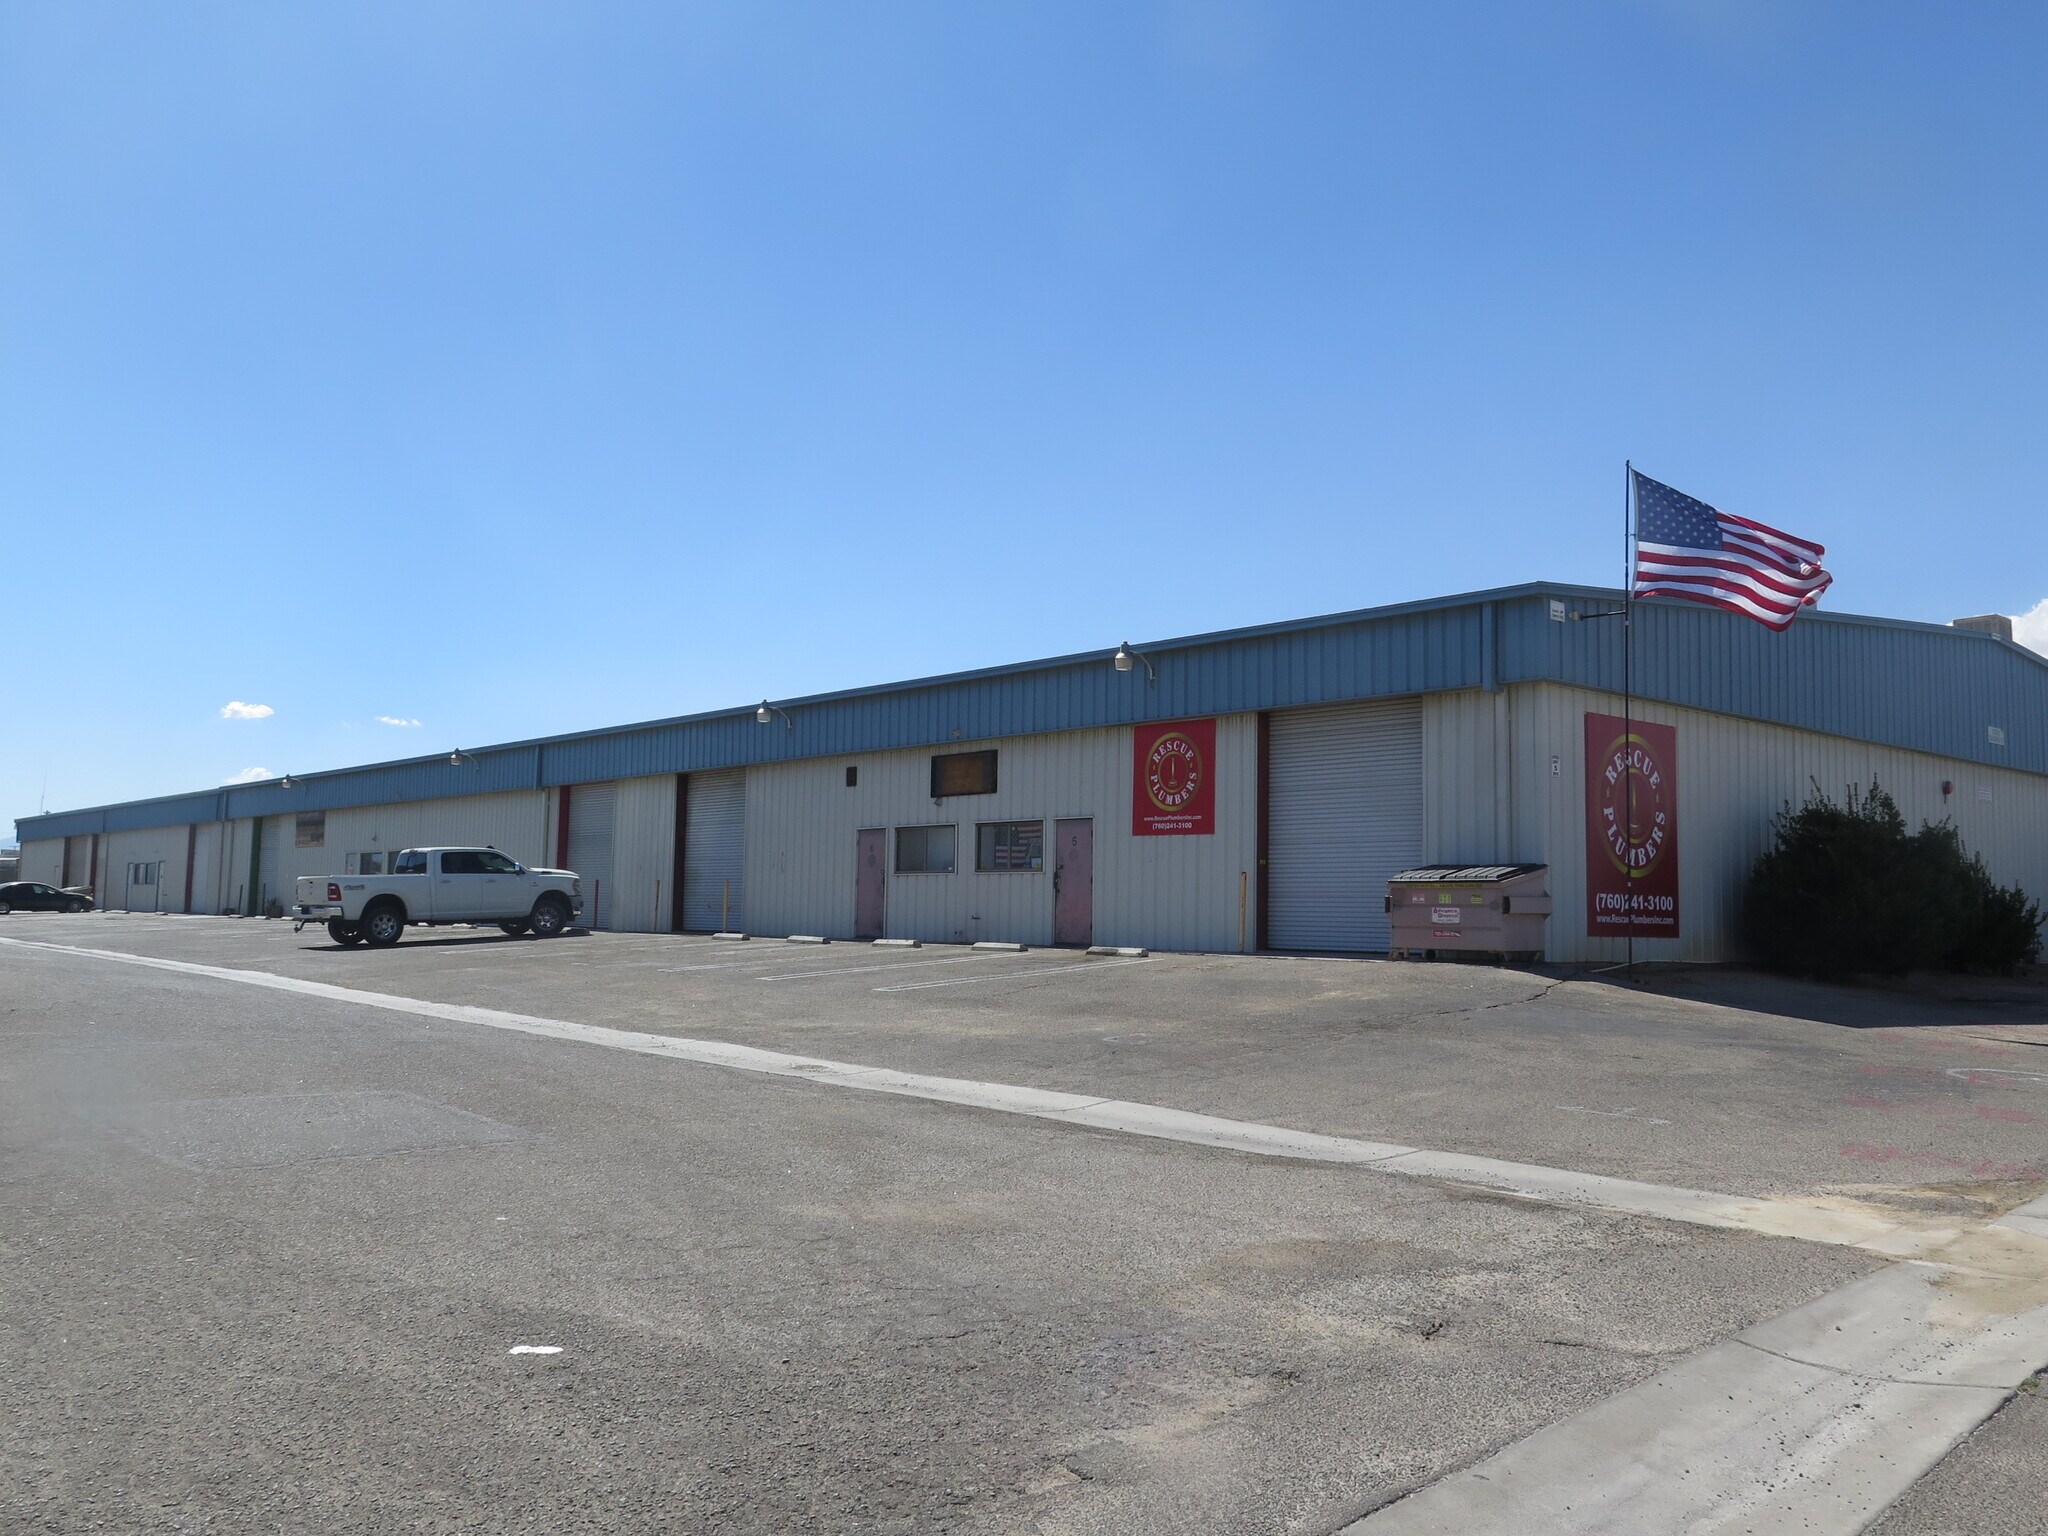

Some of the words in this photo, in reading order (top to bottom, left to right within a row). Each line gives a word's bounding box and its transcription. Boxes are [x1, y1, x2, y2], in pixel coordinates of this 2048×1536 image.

[1152, 740, 1194, 764] RESCUE
[1605, 748, 1661, 789] RESCUE
[1150, 772, 1197, 805] PLUMBERS
[1152, 822, 1192, 830] (760)241-3100
[1603, 806, 1665, 867] PLUMBERS
[1071, 836, 1077, 847] 5
